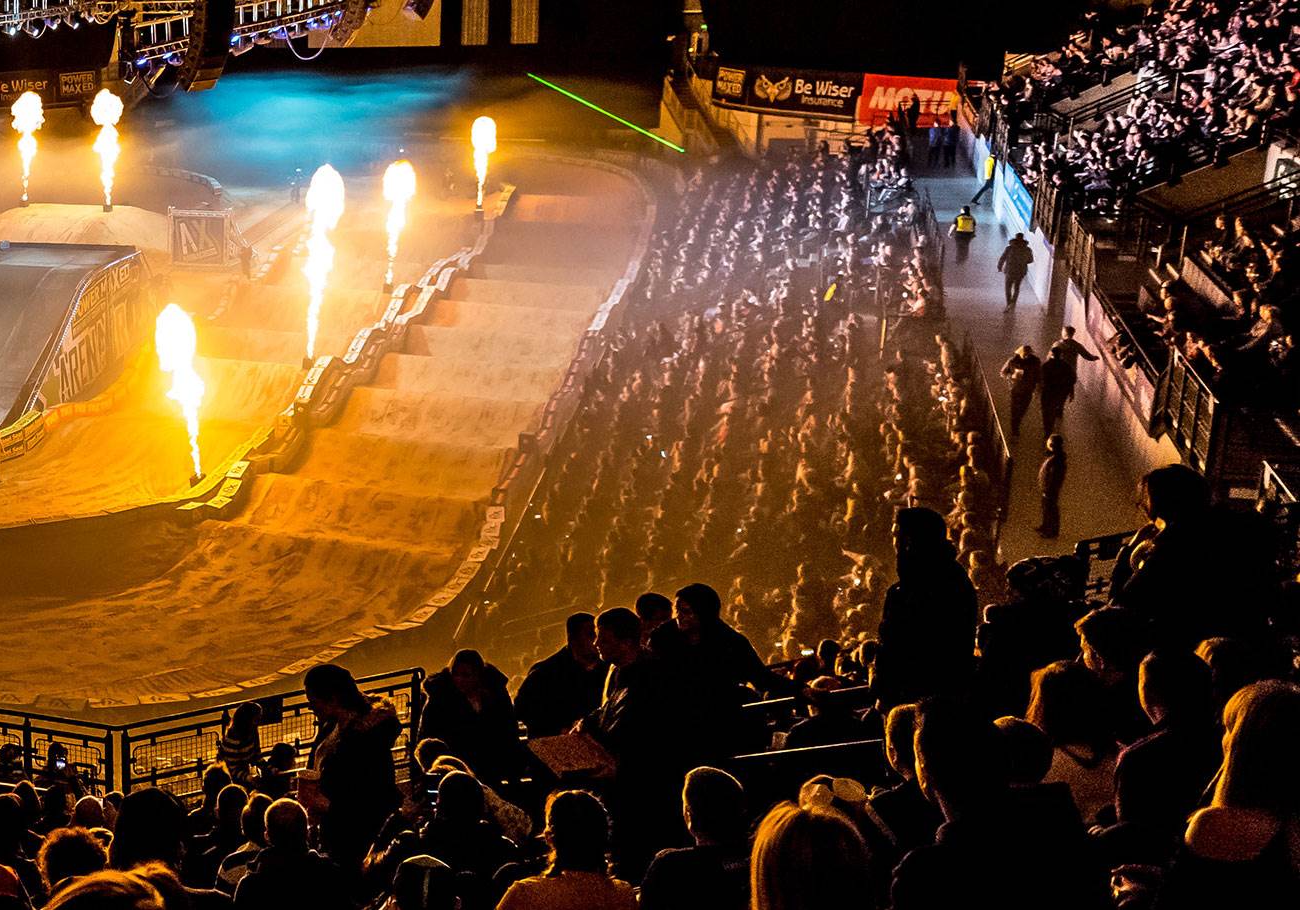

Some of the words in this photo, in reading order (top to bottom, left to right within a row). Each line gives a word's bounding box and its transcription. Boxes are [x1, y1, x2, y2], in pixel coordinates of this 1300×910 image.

[11, 79, 48, 92] Wiser
[61, 74, 93, 85] POWER
[62, 83, 94, 94] MAXED
[795, 79, 812, 95] Be
[816, 80, 855, 98] Wiser
[802, 95, 844, 108] Insurance
[869, 86, 959, 114] MOTU
